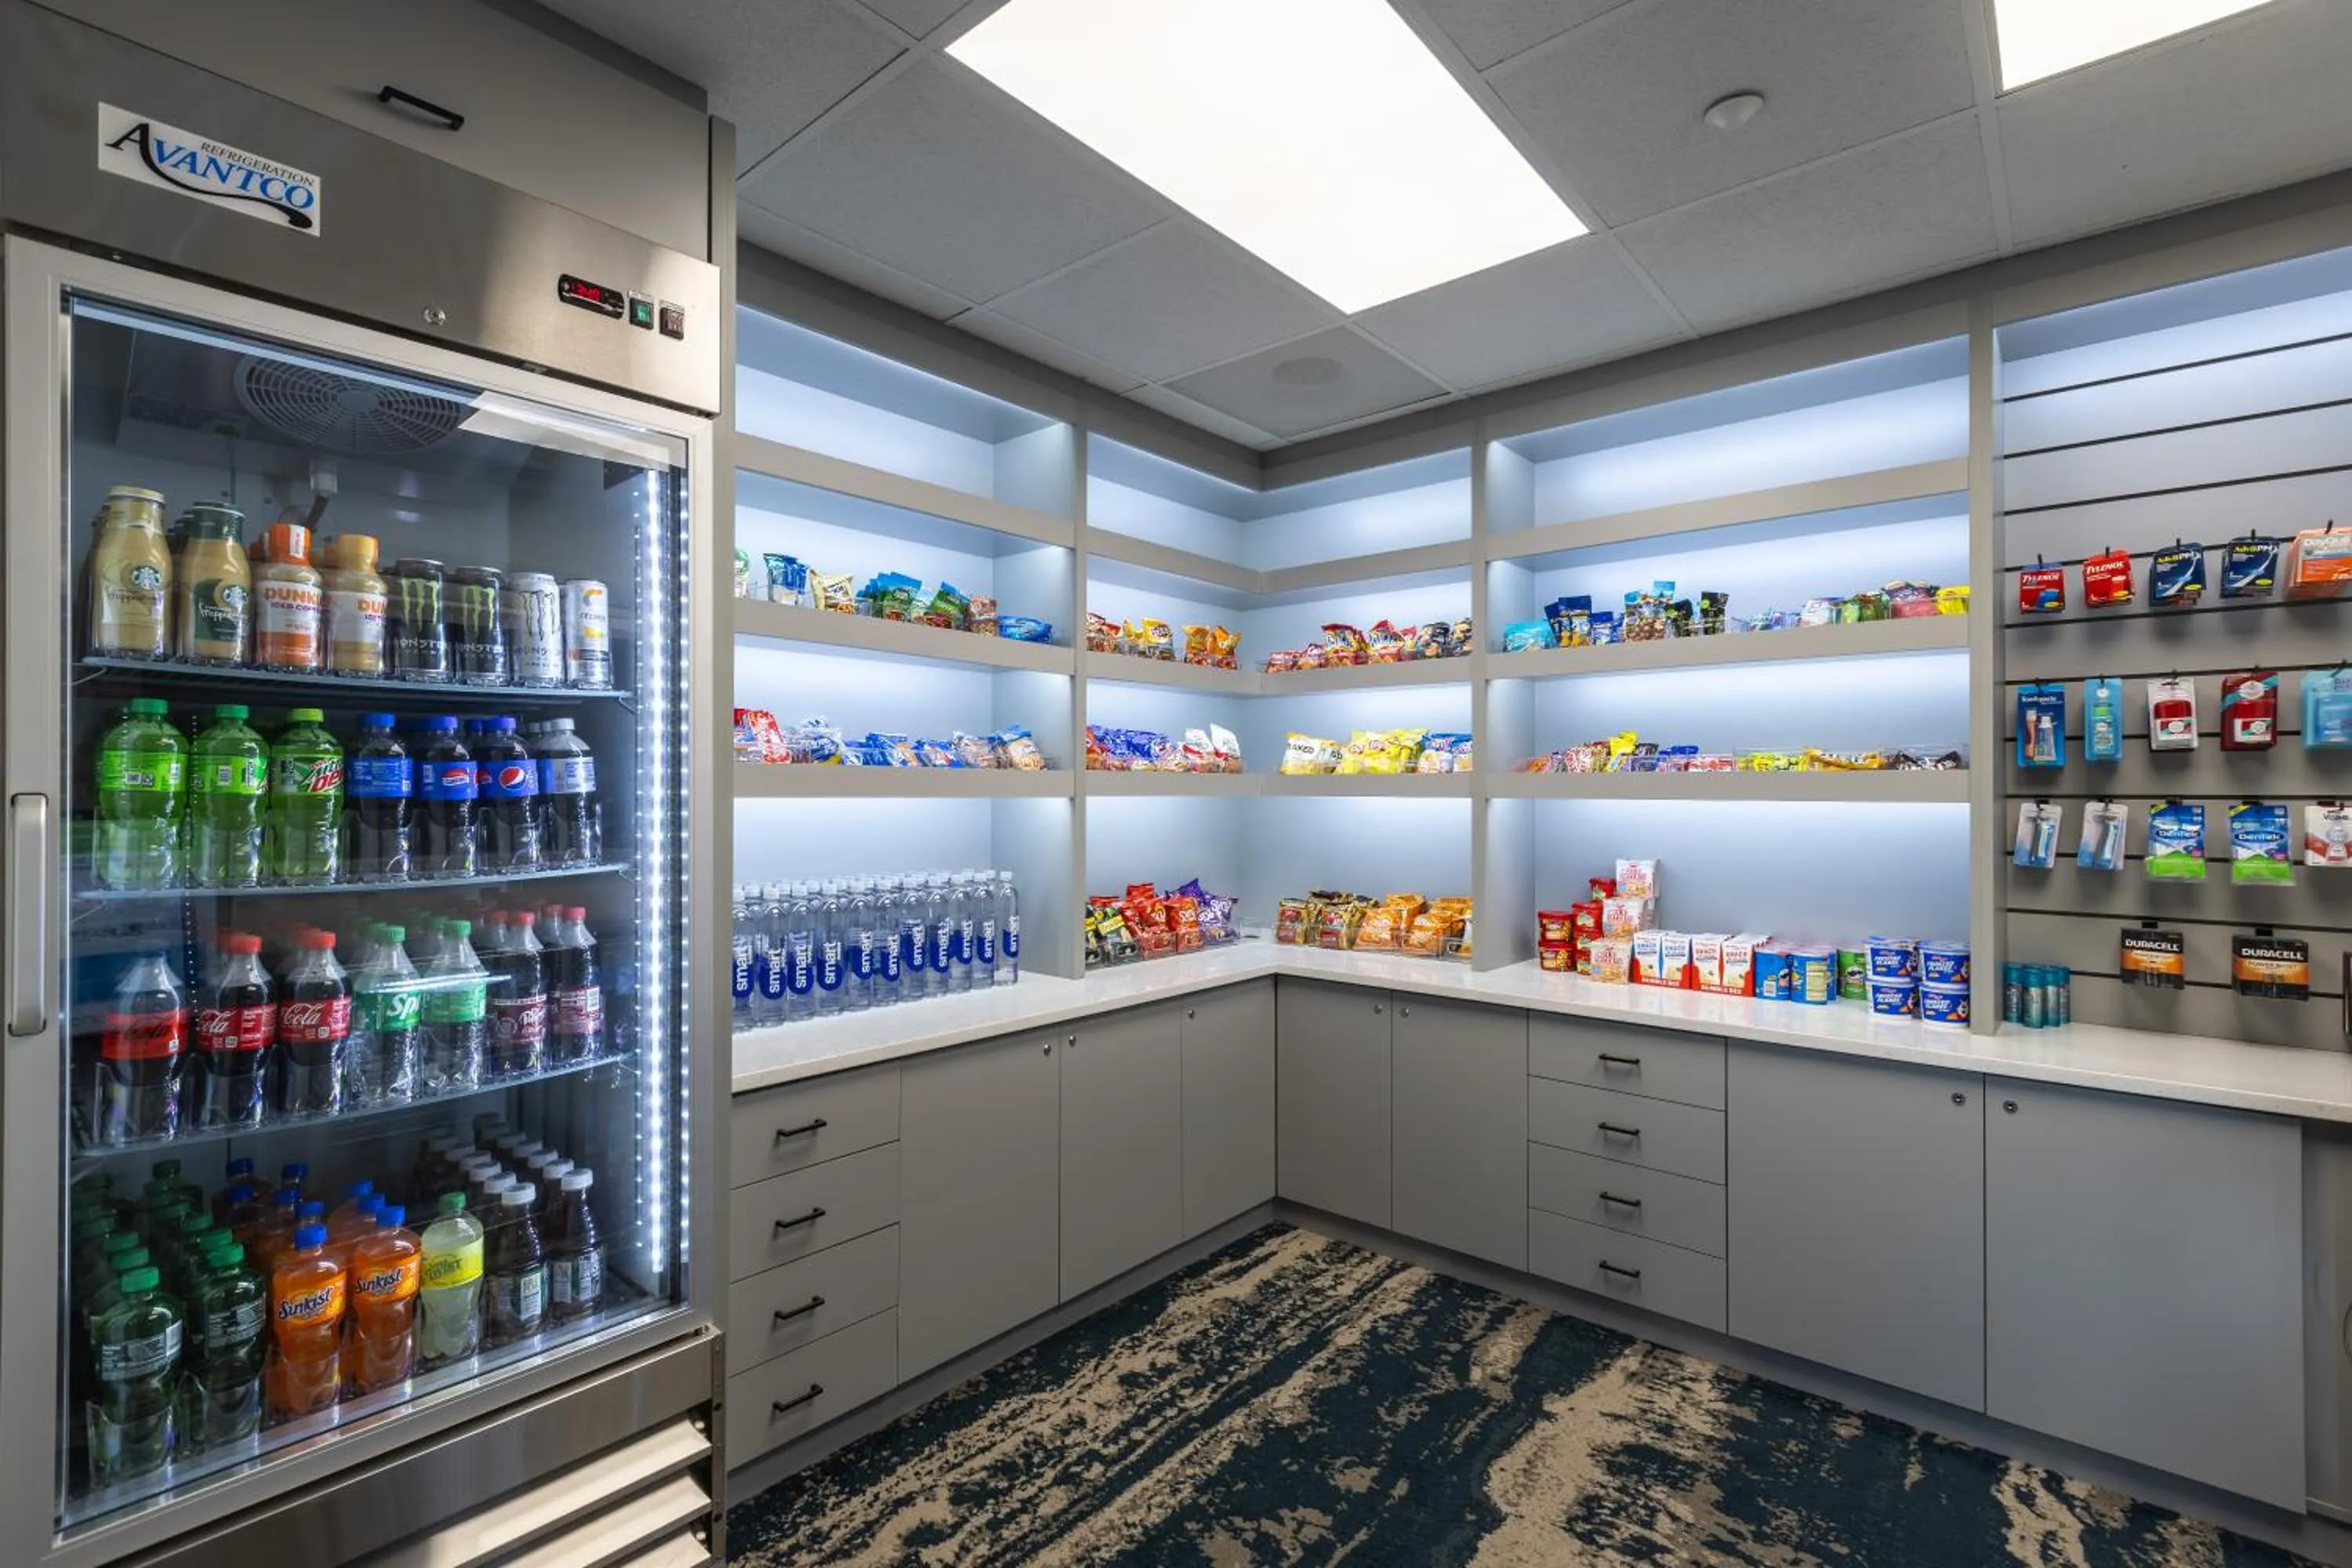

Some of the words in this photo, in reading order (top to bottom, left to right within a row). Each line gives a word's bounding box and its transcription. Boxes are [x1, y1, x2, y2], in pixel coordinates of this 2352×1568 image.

[104, 123, 314, 211] AVANTCO
[201, 141, 314, 187] REFRIGERATION
[795, 943, 808, 989] smart
[824, 941, 837, 984] smart
[887, 934, 898, 976] smart
[2125, 938, 2180, 952] DURACELL
[2241, 947, 2304, 960] DURACELL
[736, 944, 749, 991] smart
[768, 948, 782, 993] smart
[354, 1267, 404, 1294] Sunkist
[278, 1286, 333, 1319] Sunkist
